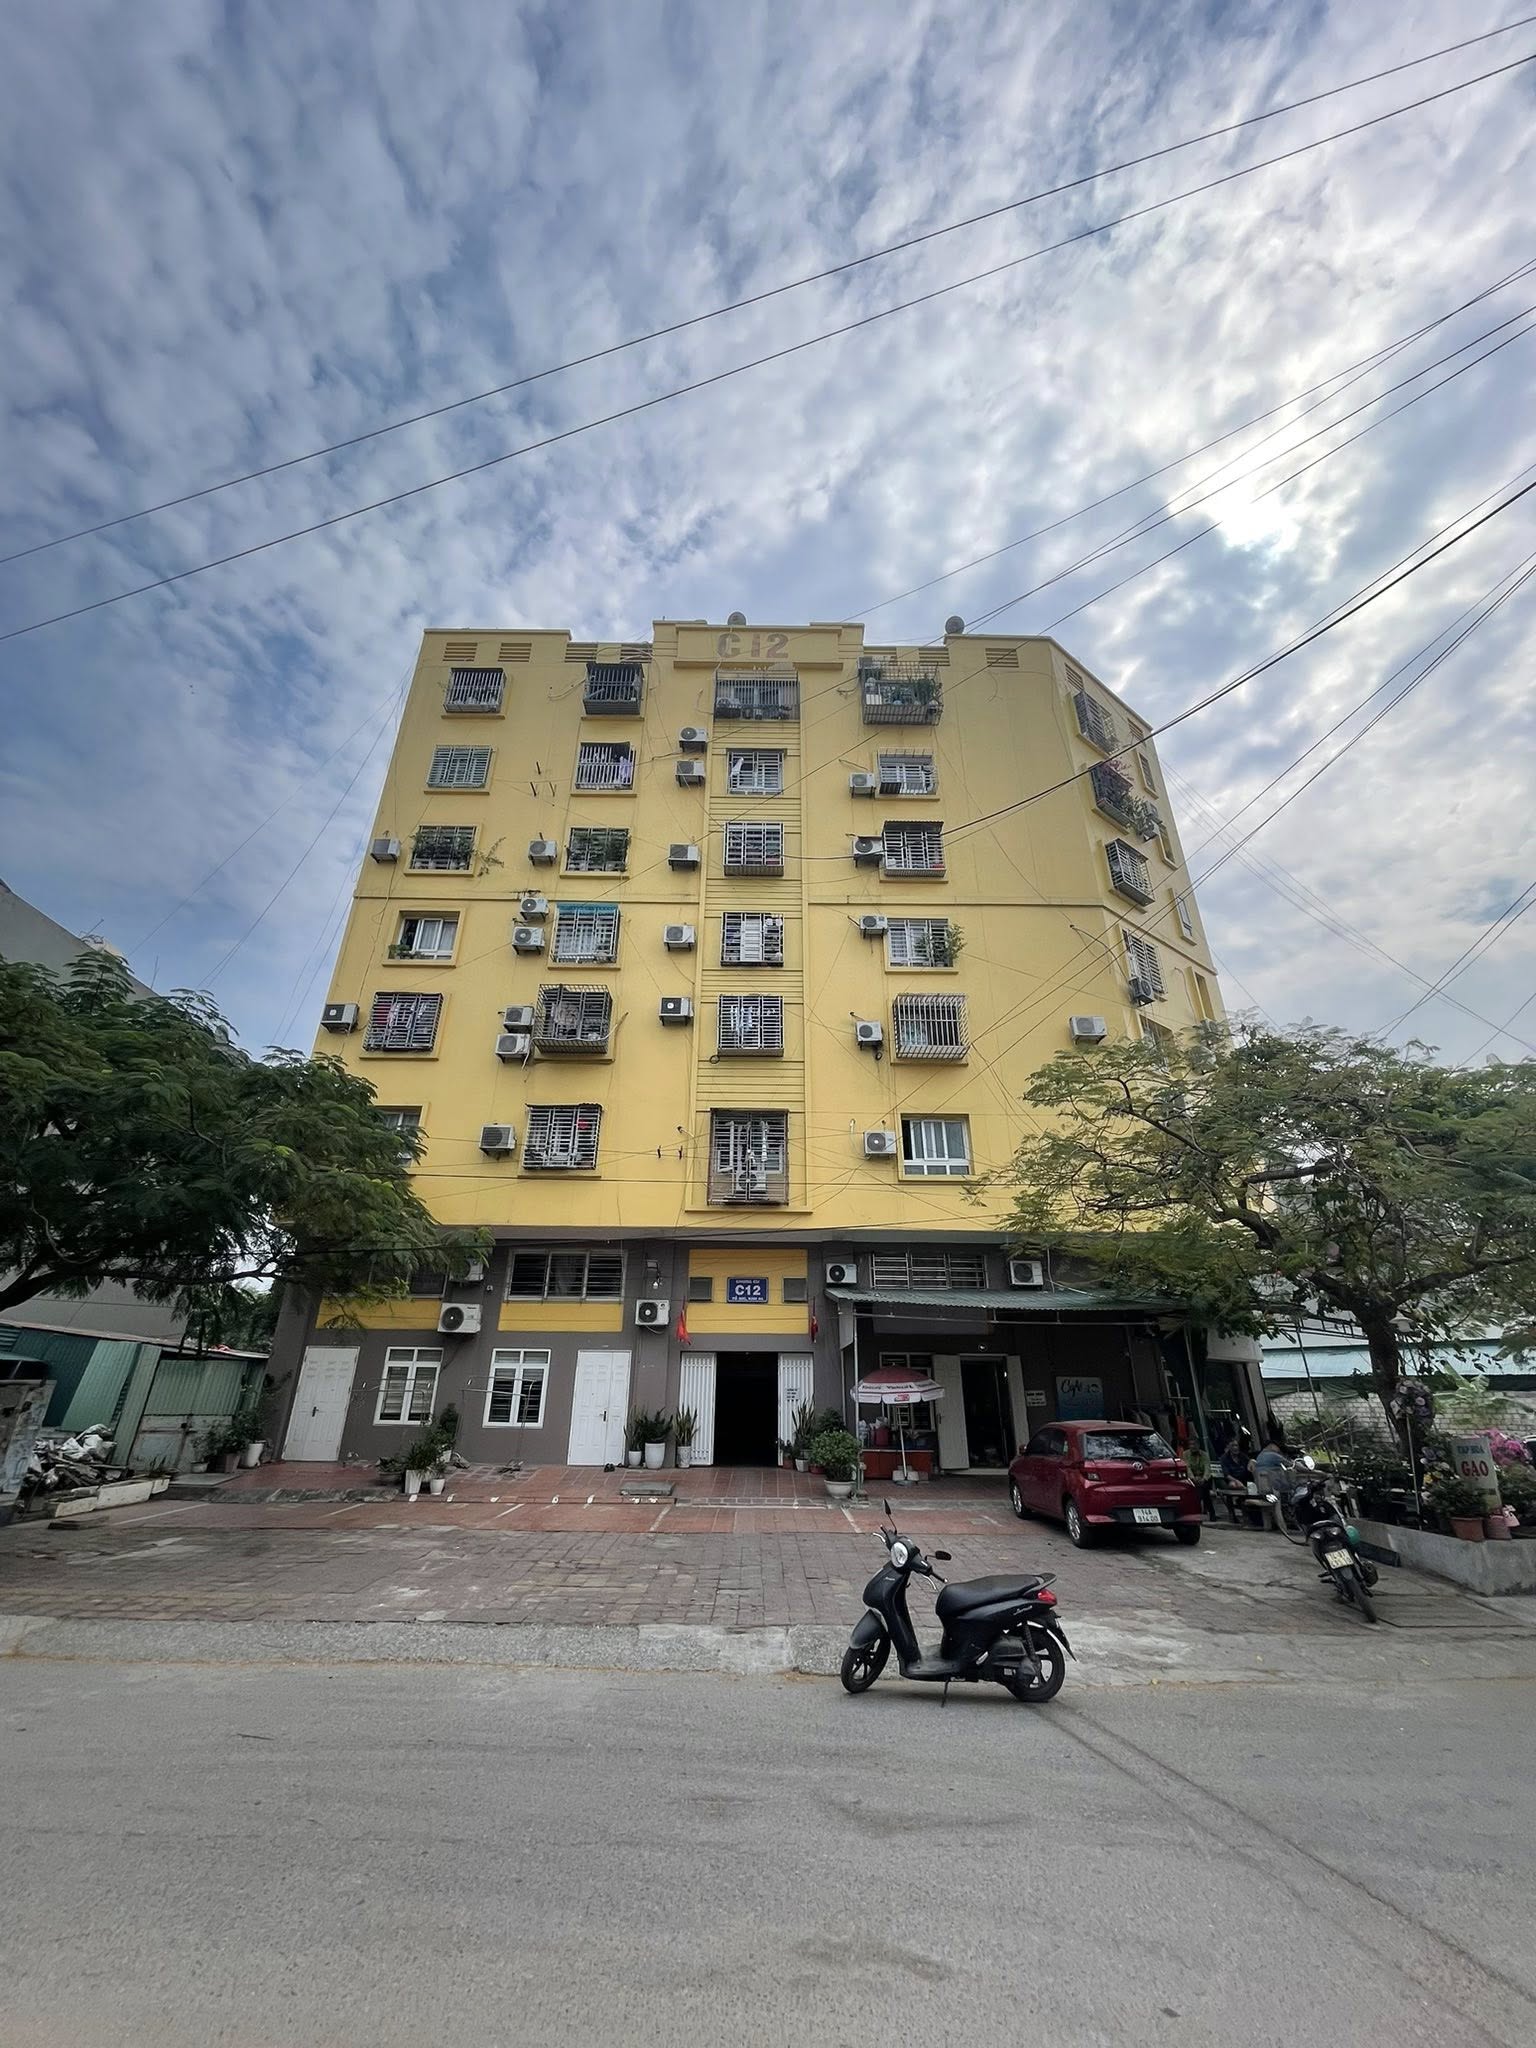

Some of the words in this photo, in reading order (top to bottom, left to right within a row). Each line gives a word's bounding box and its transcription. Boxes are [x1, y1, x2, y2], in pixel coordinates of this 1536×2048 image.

[718, 632, 789, 658] C12
[735, 1284, 761, 1295] C12
[1461, 1460, 1489, 1481] GẠO
